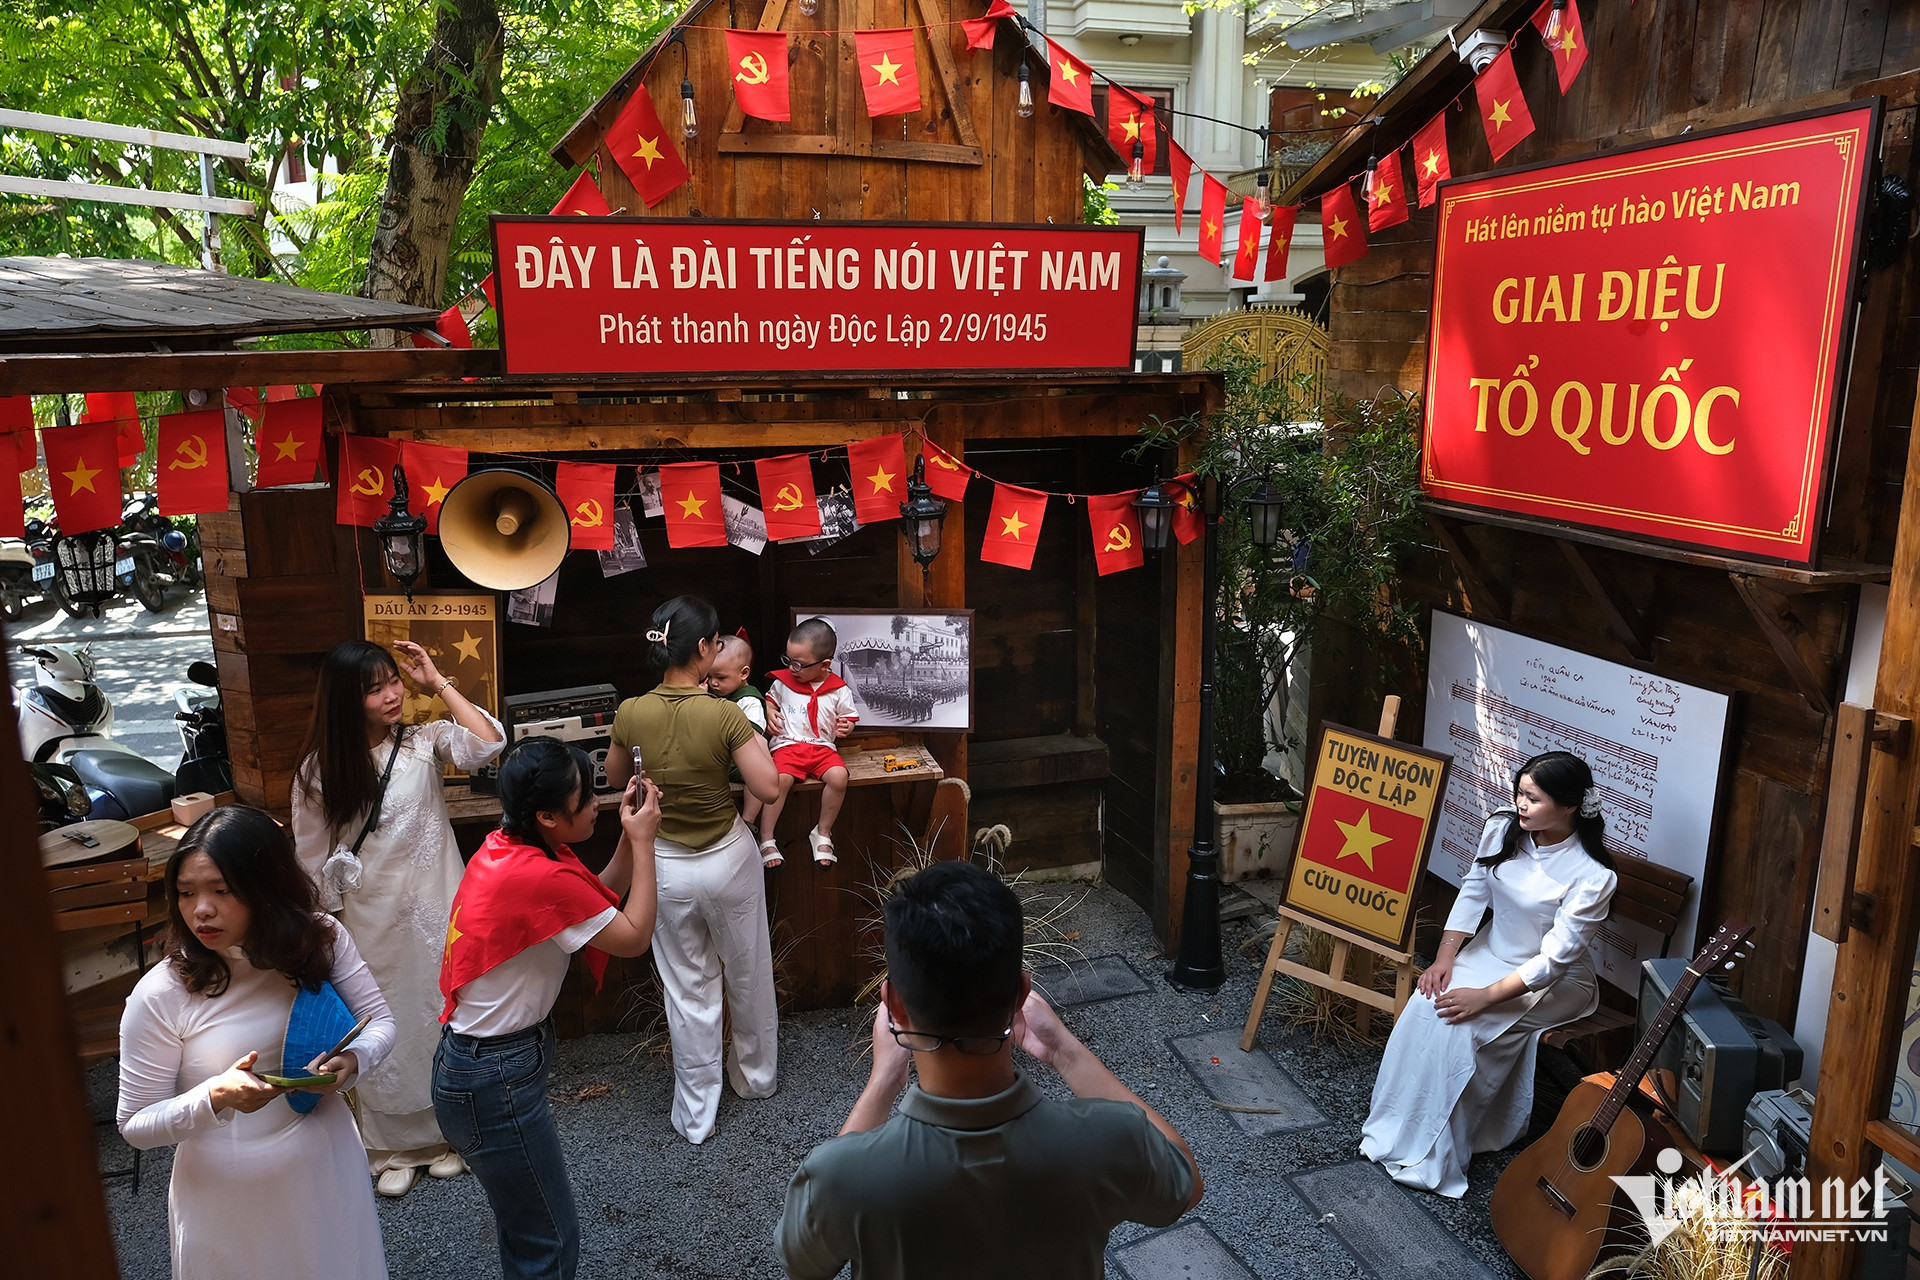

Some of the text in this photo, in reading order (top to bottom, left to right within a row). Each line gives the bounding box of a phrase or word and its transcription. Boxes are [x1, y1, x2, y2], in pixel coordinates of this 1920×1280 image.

[1464, 180, 1801, 243] Hát lên niềm tự hào Việt Nam
[515, 234, 1121, 297] ĐÂY LÀ ĐÀI TIẾNG NÓI VIỆT NAM
[1492, 254, 1727, 333] GIAI ĐIỆU
[600, 313, 1048, 349] Phát thanh ngày Độc Lập 2/9/1945
[1469, 354, 1741, 457] TỔ QUỐC
[375, 600, 403, 615] DẤU
[431, 604, 487, 615] 2-9-1945
[1328, 739, 1380, 772] TUYÊN
[1381, 756, 1435, 788] NGÔN
[1332, 767, 1372, 794] ĐỘC
[1378, 782, 1417, 807] LẬP
[1304, 868, 1399, 917] CỨU QUỐC
